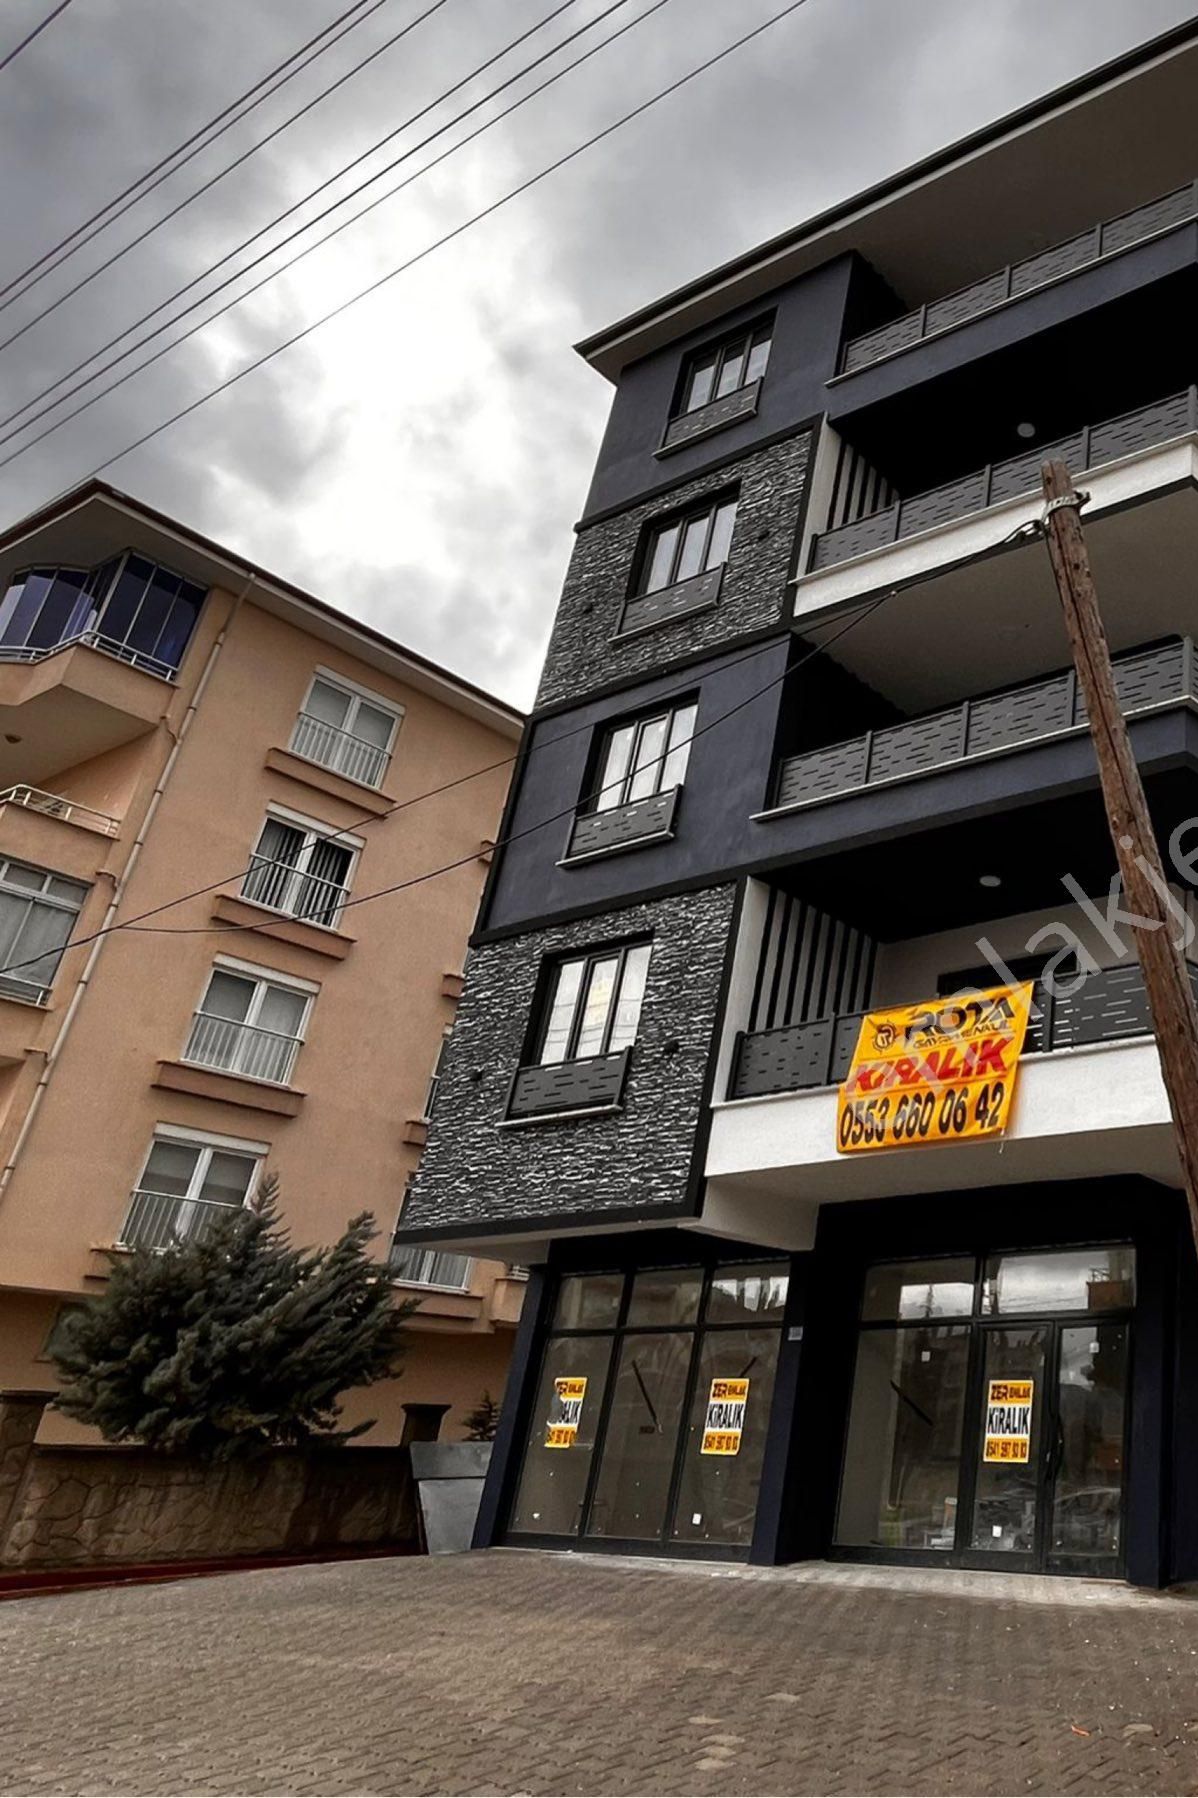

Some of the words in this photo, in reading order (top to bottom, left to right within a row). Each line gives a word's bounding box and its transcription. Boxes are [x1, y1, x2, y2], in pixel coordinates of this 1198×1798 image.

[938, 1086, 970, 1134] 06
[974, 1081, 1004, 1130] 42
[713, 1383, 727, 1398] ZER
[991, 1385, 1009, 1400] ZER
